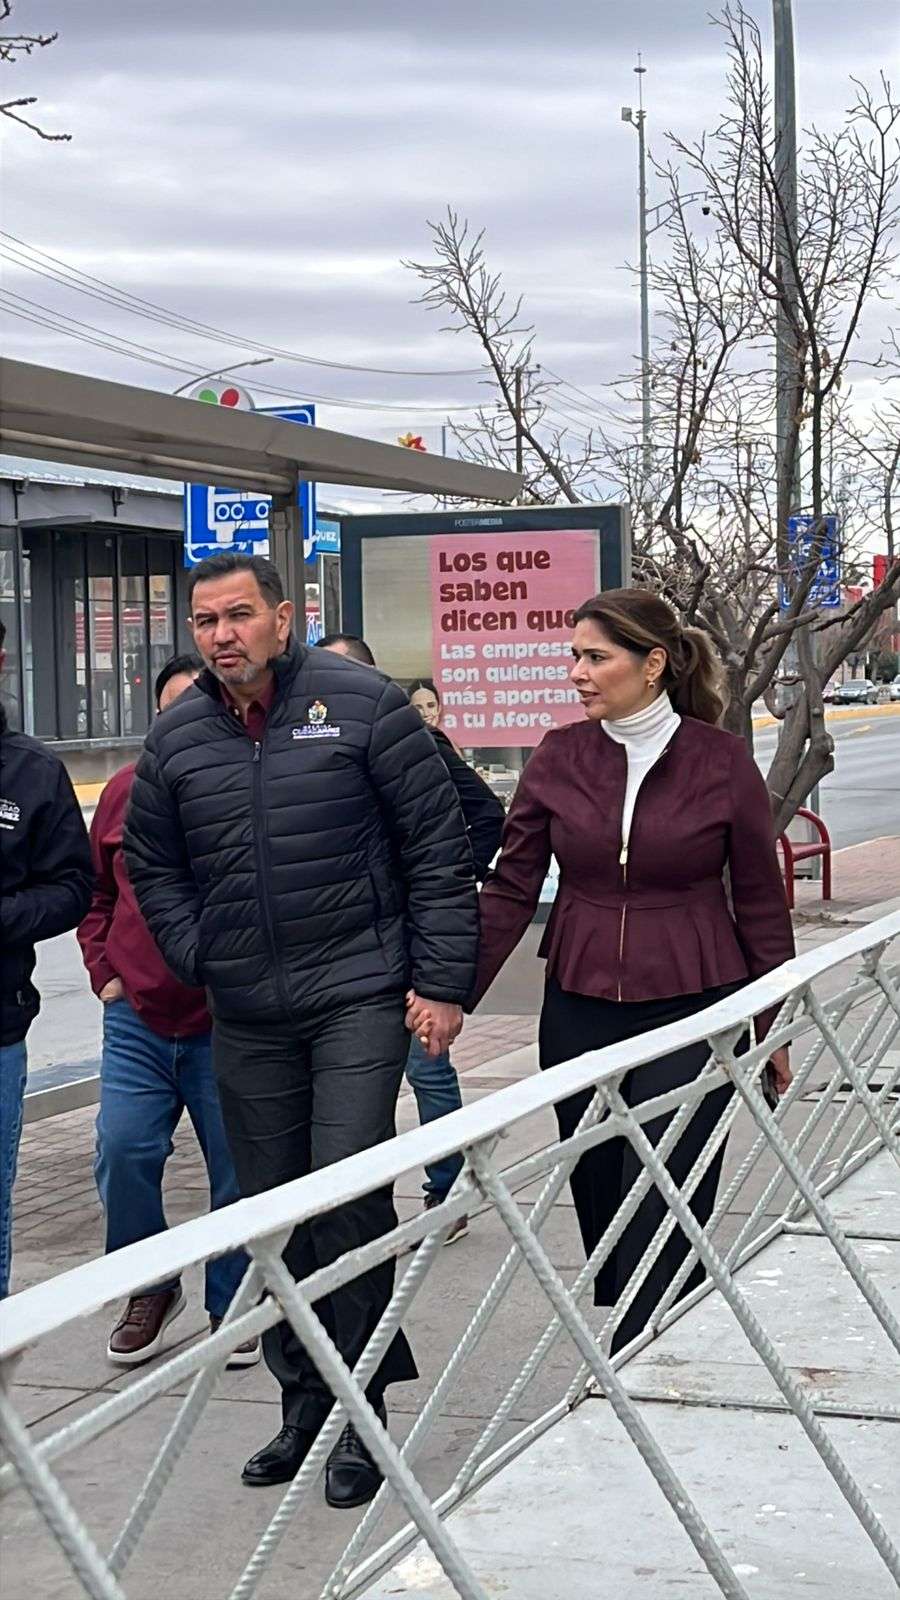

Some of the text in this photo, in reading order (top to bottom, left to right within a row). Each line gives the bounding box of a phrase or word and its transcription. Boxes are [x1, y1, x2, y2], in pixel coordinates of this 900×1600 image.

[439, 550, 551, 573] Los que
[440, 579, 528, 602] saben
[441, 609, 517, 632] dicen
[441, 641, 574, 659] Las empresa
[441, 664, 568, 683] son quienes
[442, 685, 581, 706] más aportan
[444, 711, 558, 728] a tu Afore.
